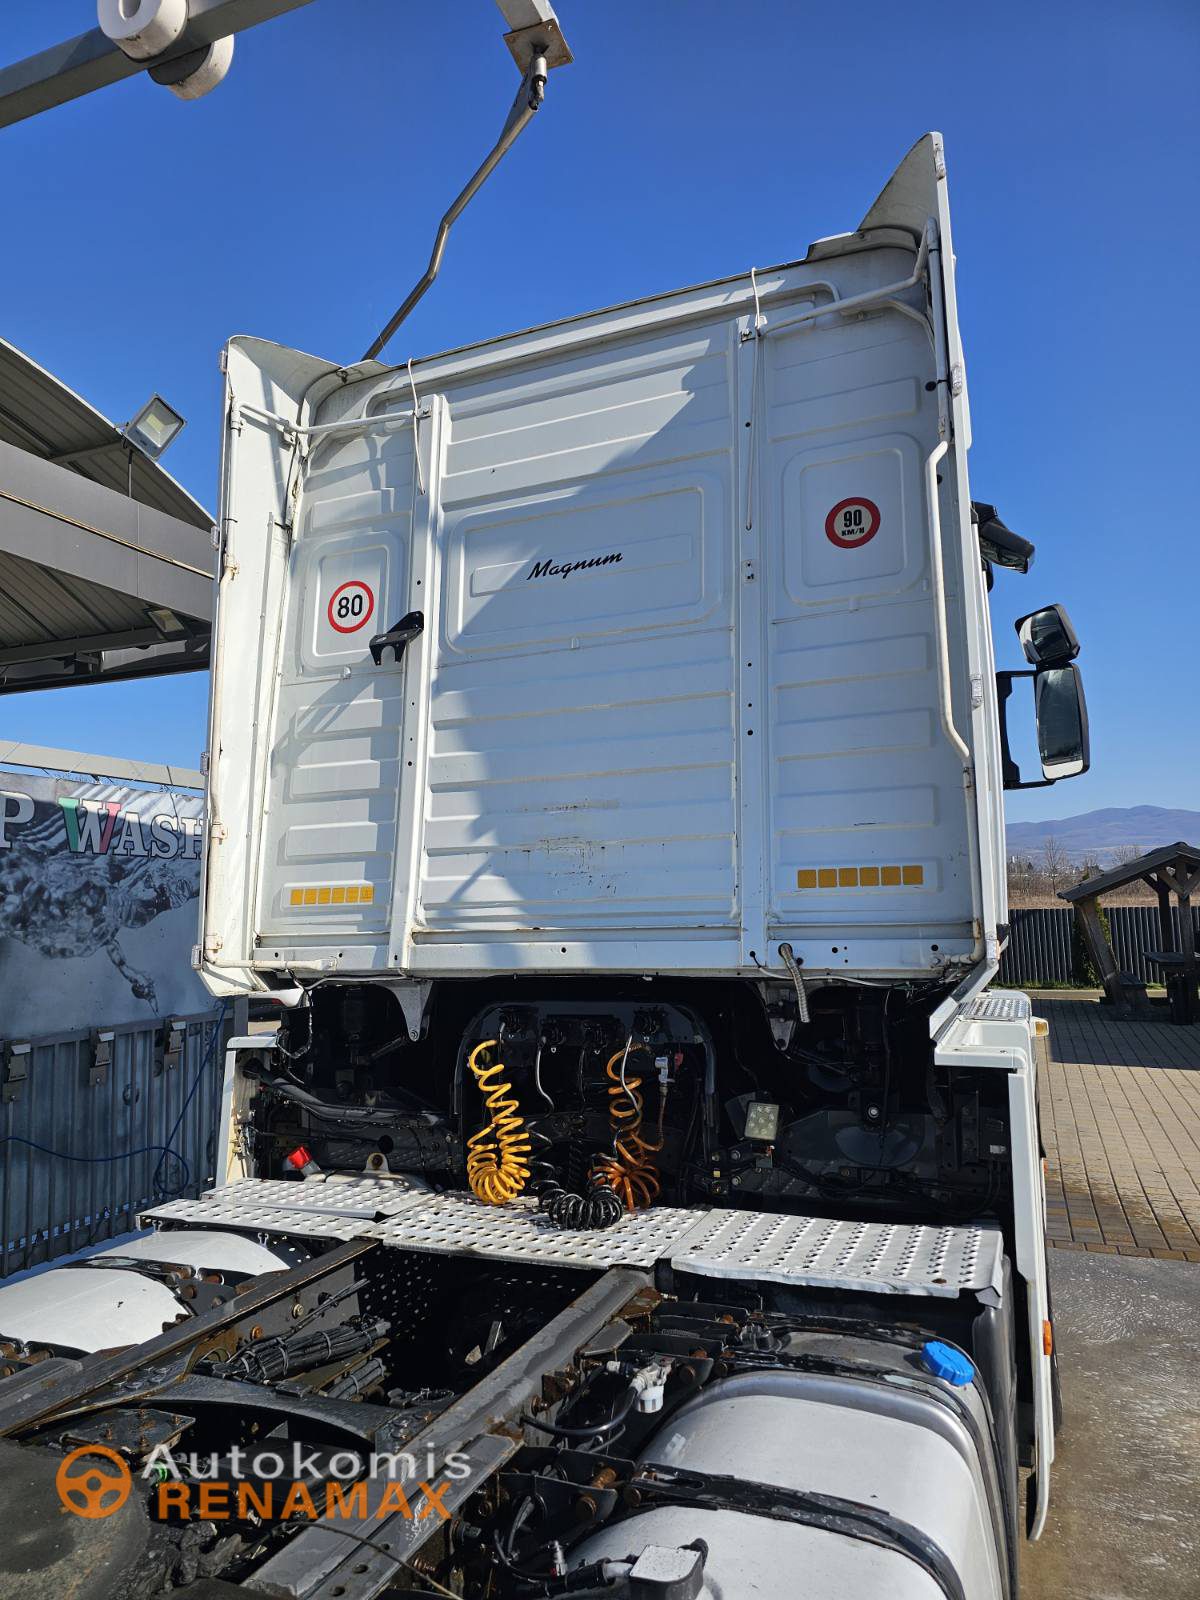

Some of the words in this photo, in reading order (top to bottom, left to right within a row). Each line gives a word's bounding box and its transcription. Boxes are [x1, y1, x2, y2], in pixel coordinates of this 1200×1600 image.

[843, 509, 862, 527] 90
[526, 552, 623, 580] Magnum
[337, 594, 363, 618] 80
